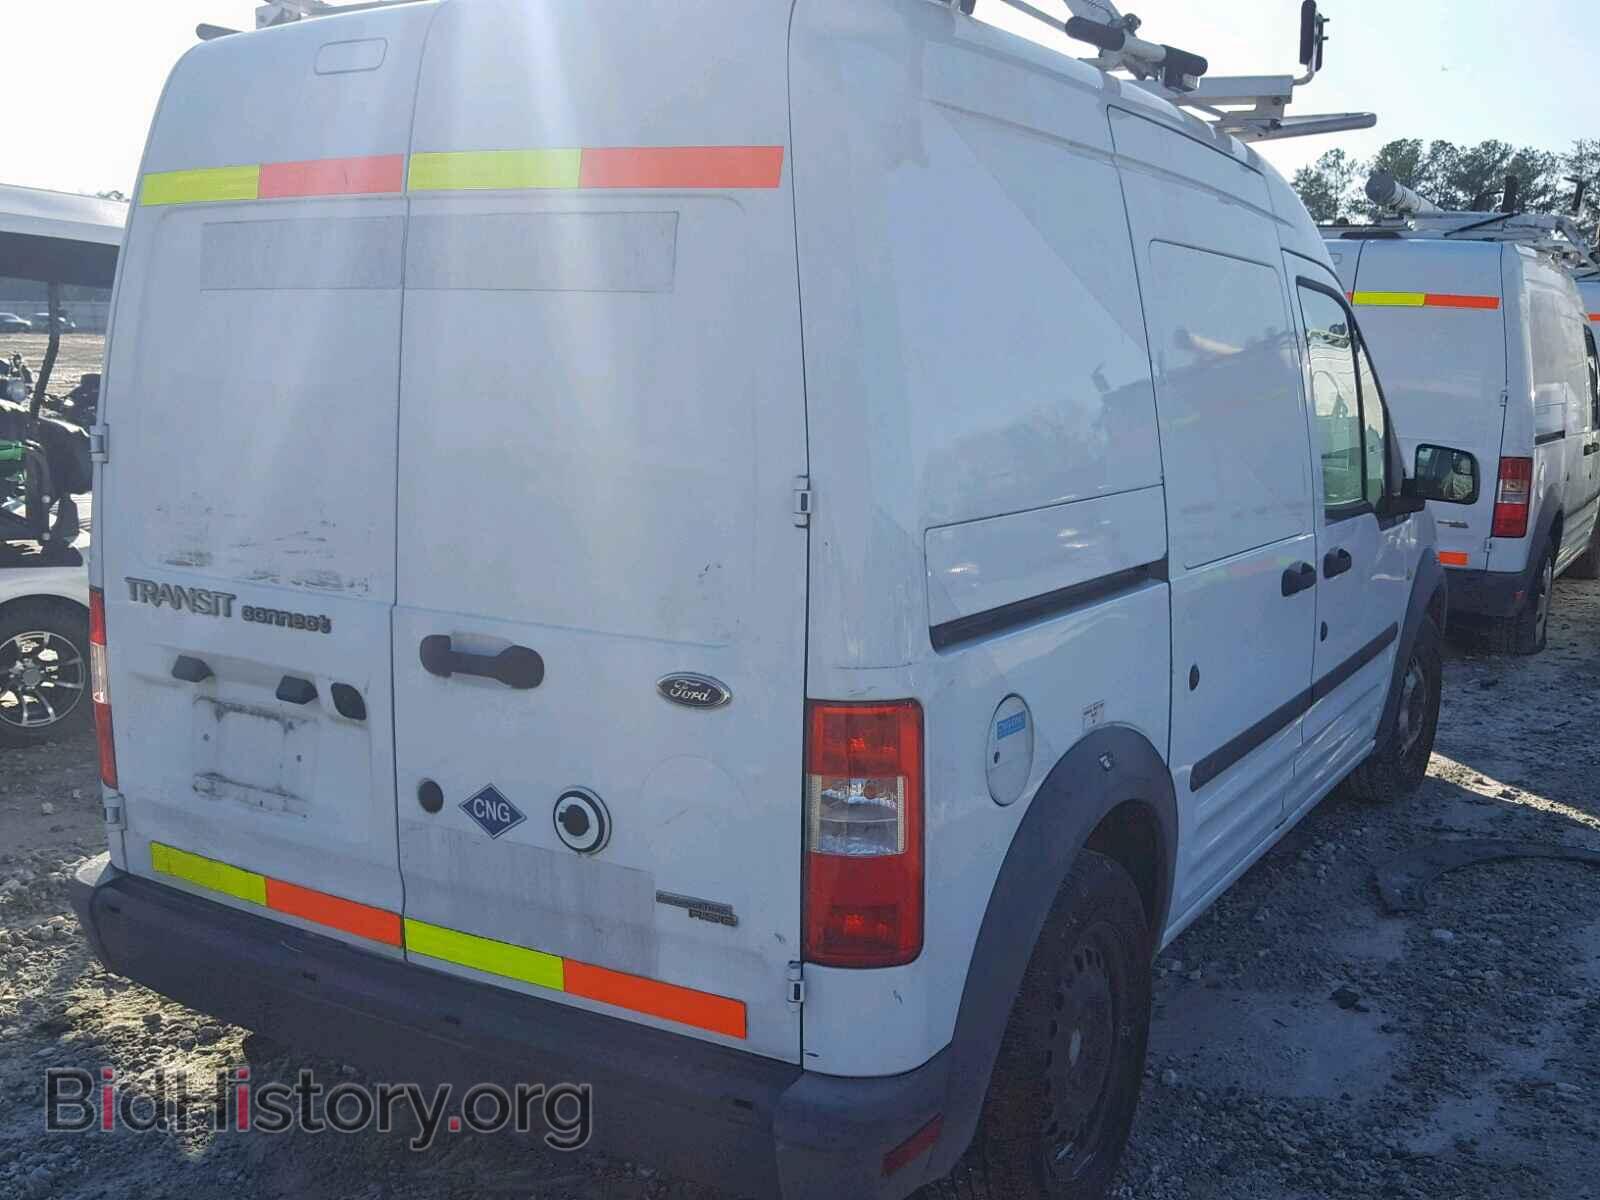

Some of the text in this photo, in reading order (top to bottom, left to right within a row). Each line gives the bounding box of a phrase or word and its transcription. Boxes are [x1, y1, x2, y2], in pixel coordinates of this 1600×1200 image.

[124, 576, 332, 634] TRANSIT connect
[669, 679, 712, 701] Ford
[473, 798, 511, 823] CNG
